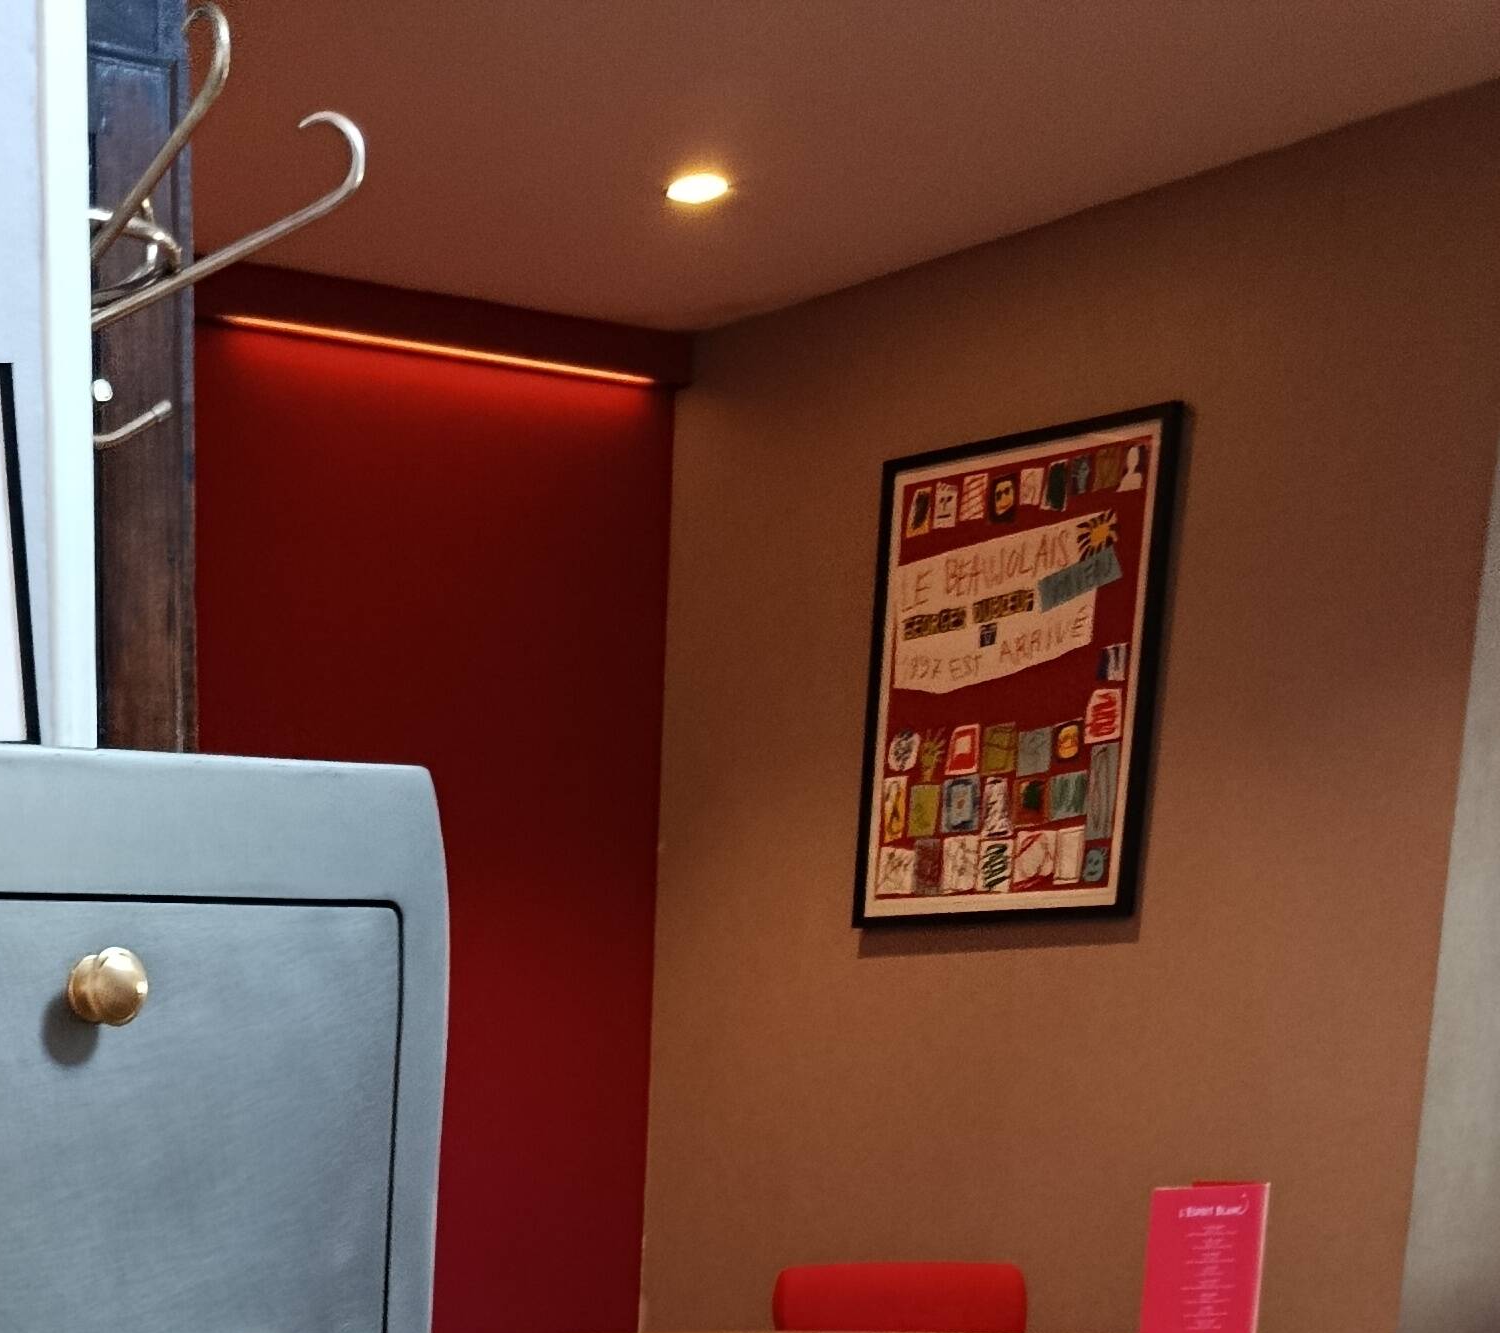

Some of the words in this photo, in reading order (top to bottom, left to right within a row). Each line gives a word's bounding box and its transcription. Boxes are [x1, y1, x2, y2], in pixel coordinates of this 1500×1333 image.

[900, 569, 933, 613] LE
[944, 527, 1071, 597] BEAUJOLAIS
[948, 653, 982, 682] EST
[1000, 604, 1090, 665] ARRIVÉ
